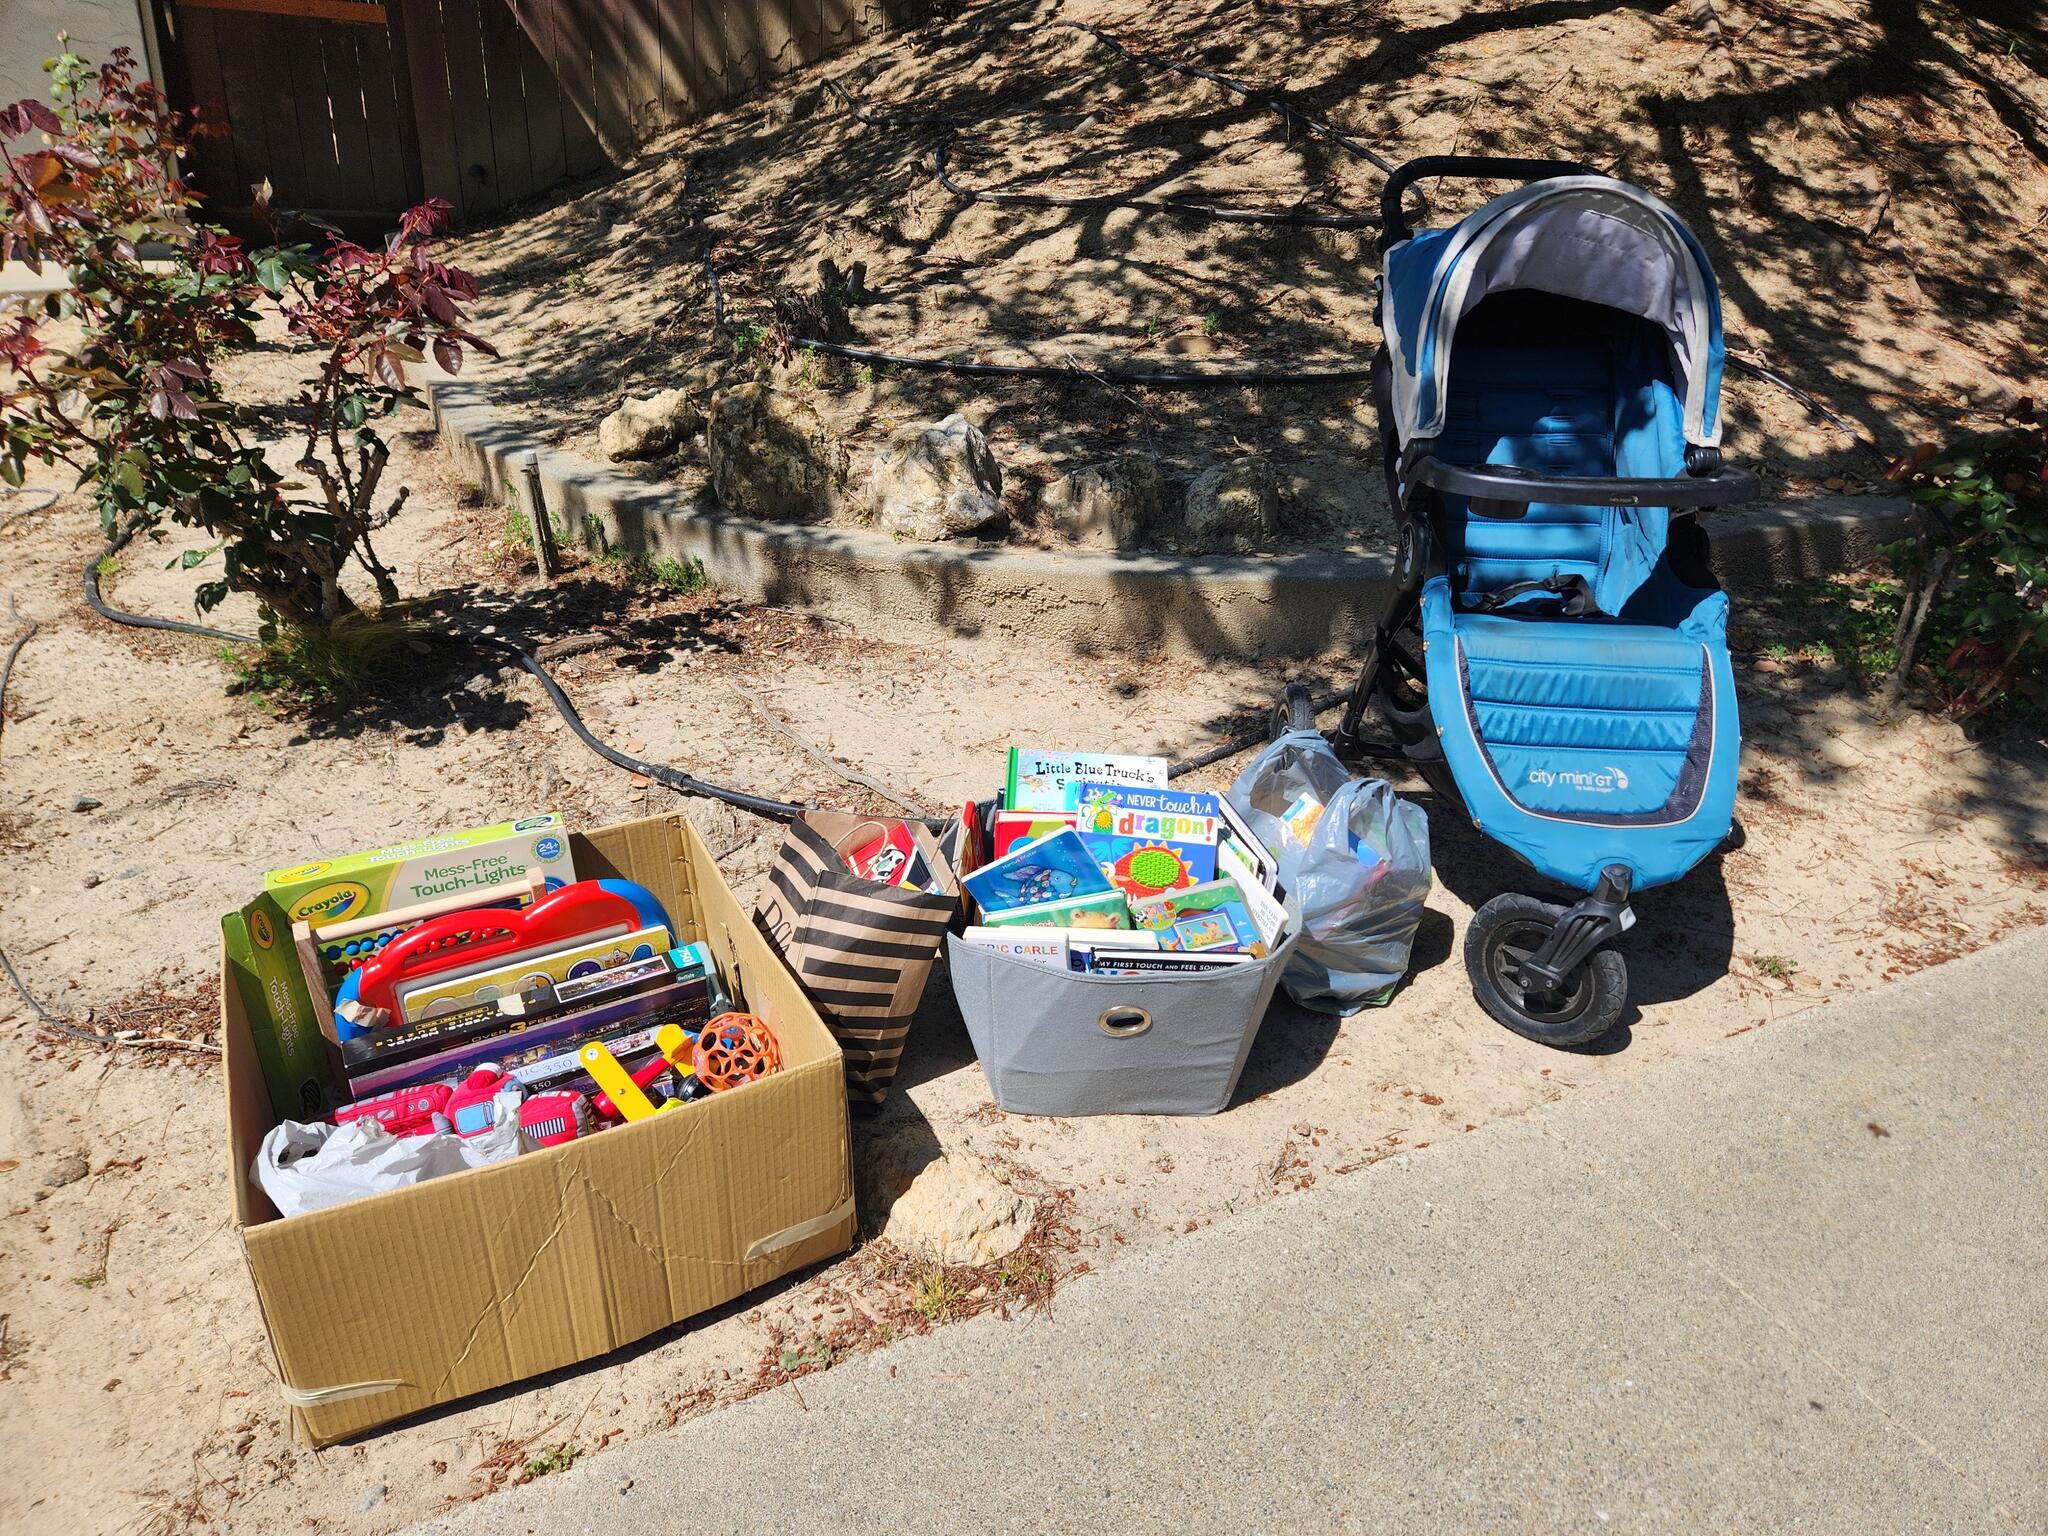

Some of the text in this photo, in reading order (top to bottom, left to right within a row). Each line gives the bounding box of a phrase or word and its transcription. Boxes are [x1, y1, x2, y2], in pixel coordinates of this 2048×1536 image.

[1035, 761, 1071, 776] Little
[1075, 762, 1103, 776] Blue
[1104, 764, 1155, 784] Truck's
[1529, 768, 1613, 788] city mini GT
[1126, 792, 1212, 815] NEVER touch A
[1119, 812, 1214, 842] dragon!
[538, 842, 559, 853] 24+
[424, 855, 508, 881] Mess-Free
[410, 864, 527, 898] Touch-Lights
[298, 888, 353, 917] Crayola
[978, 943, 1059, 955] RIC CARLE
[1135, 962, 1163, 970] TOUCH
[269, 976, 296, 1057] Touch-Lights
[279, 980, 300, 1039] Mess-Free
[509, 1021, 527, 1035] 3
[528, 1013, 560, 1026] FEET
[543, 1059, 573, 1075] 350
[531, 1080, 552, 1092] 350
